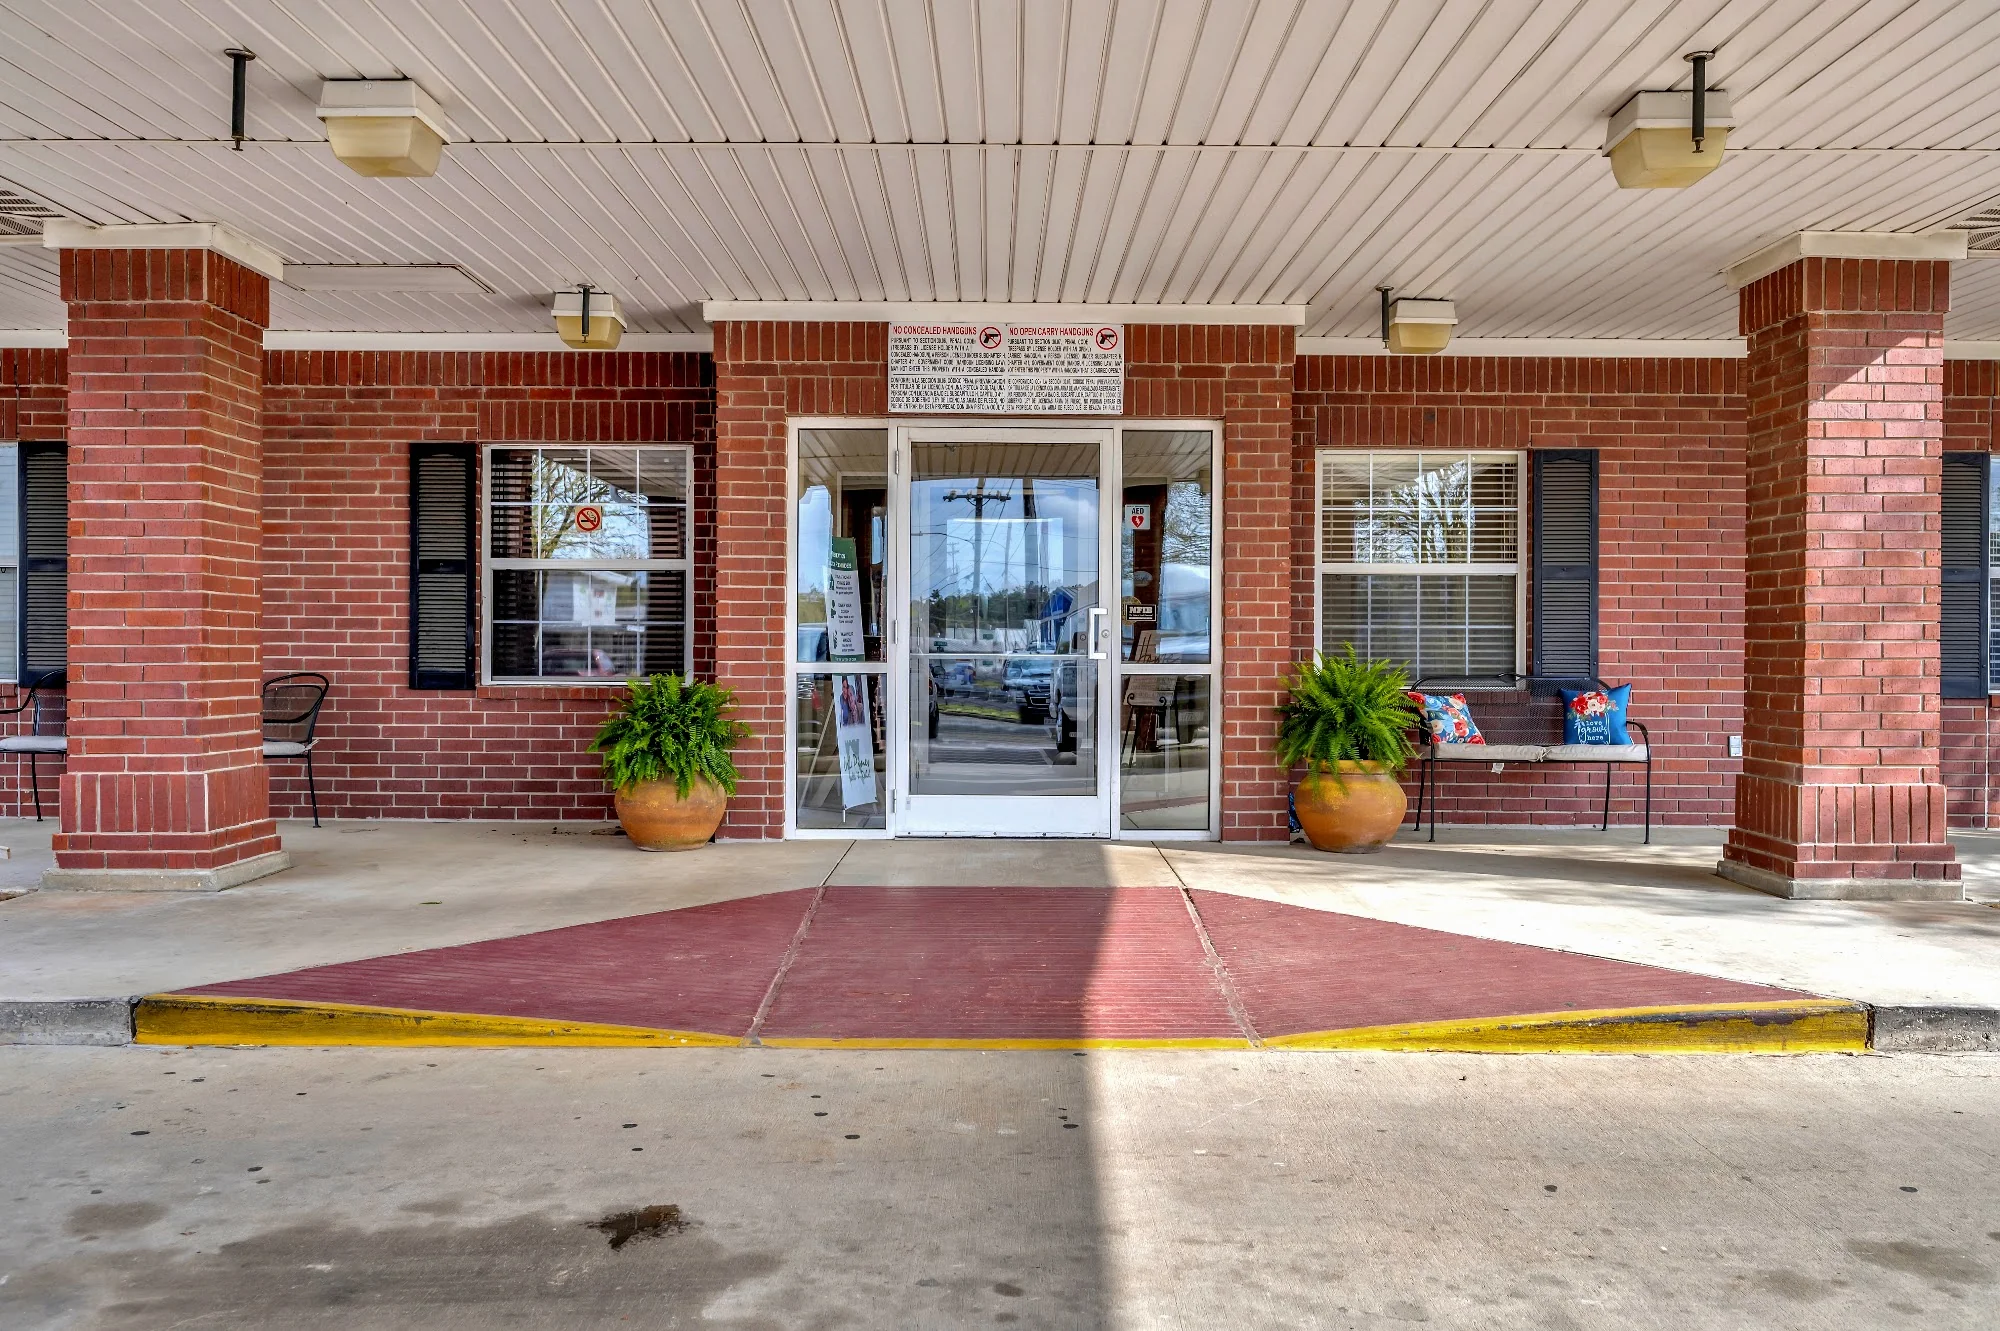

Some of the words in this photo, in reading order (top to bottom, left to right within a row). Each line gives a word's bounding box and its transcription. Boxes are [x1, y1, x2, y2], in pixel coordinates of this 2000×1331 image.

[893, 326, 902, 335] NO
[903, 326, 942, 335] CONCEALED
[943, 326, 977, 335] HANDGUNS
[1009, 327, 1019, 336] NO
[1020, 327, 1037, 336] OPEN
[1037, 327, 1059, 336] CARRY
[1060, 327, 1094, 336] HANDGUNS
